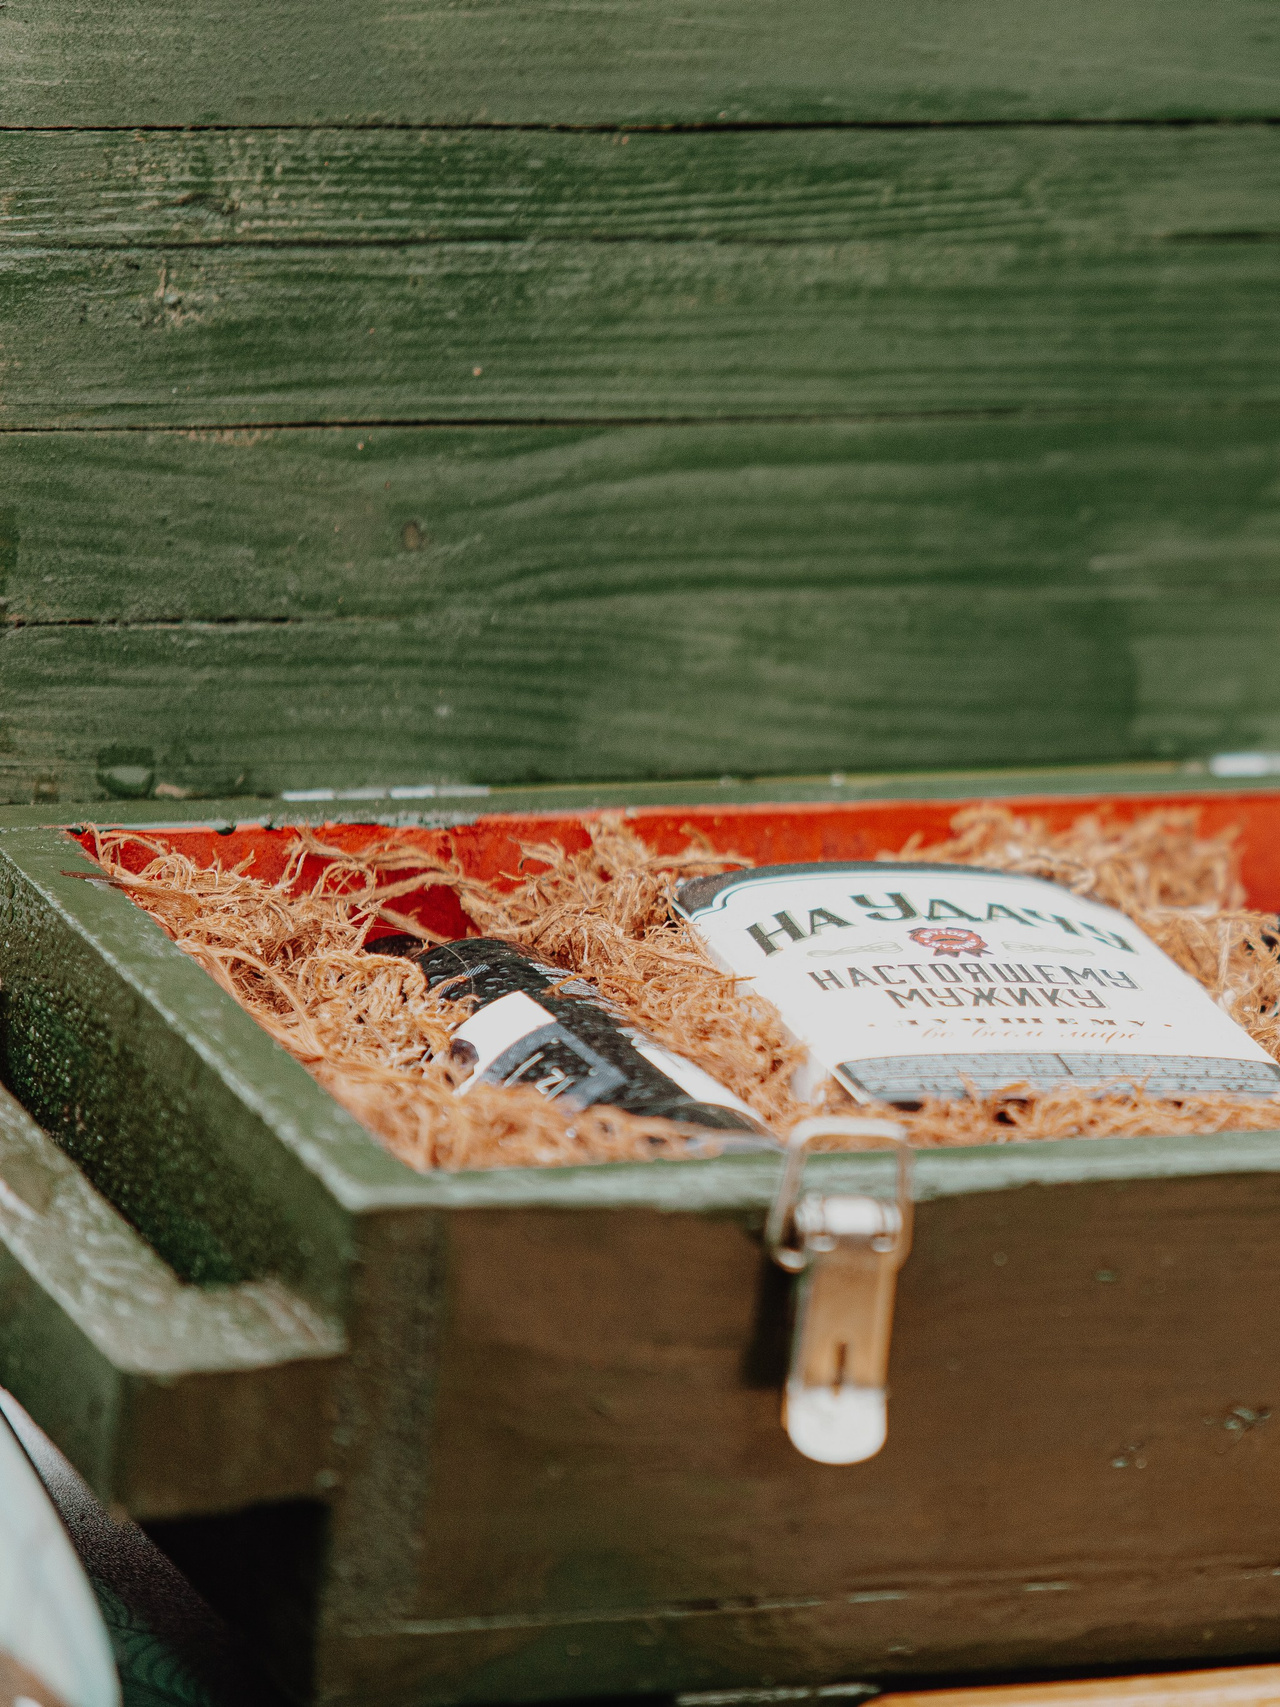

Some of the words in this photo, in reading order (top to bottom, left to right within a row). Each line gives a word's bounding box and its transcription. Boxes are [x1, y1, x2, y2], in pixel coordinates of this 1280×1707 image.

[745, 908, 857, 957] НА
[849, 892, 1137, 954] УДАЧУ
[883, 987, 1110, 1010] МУЖИКУ
